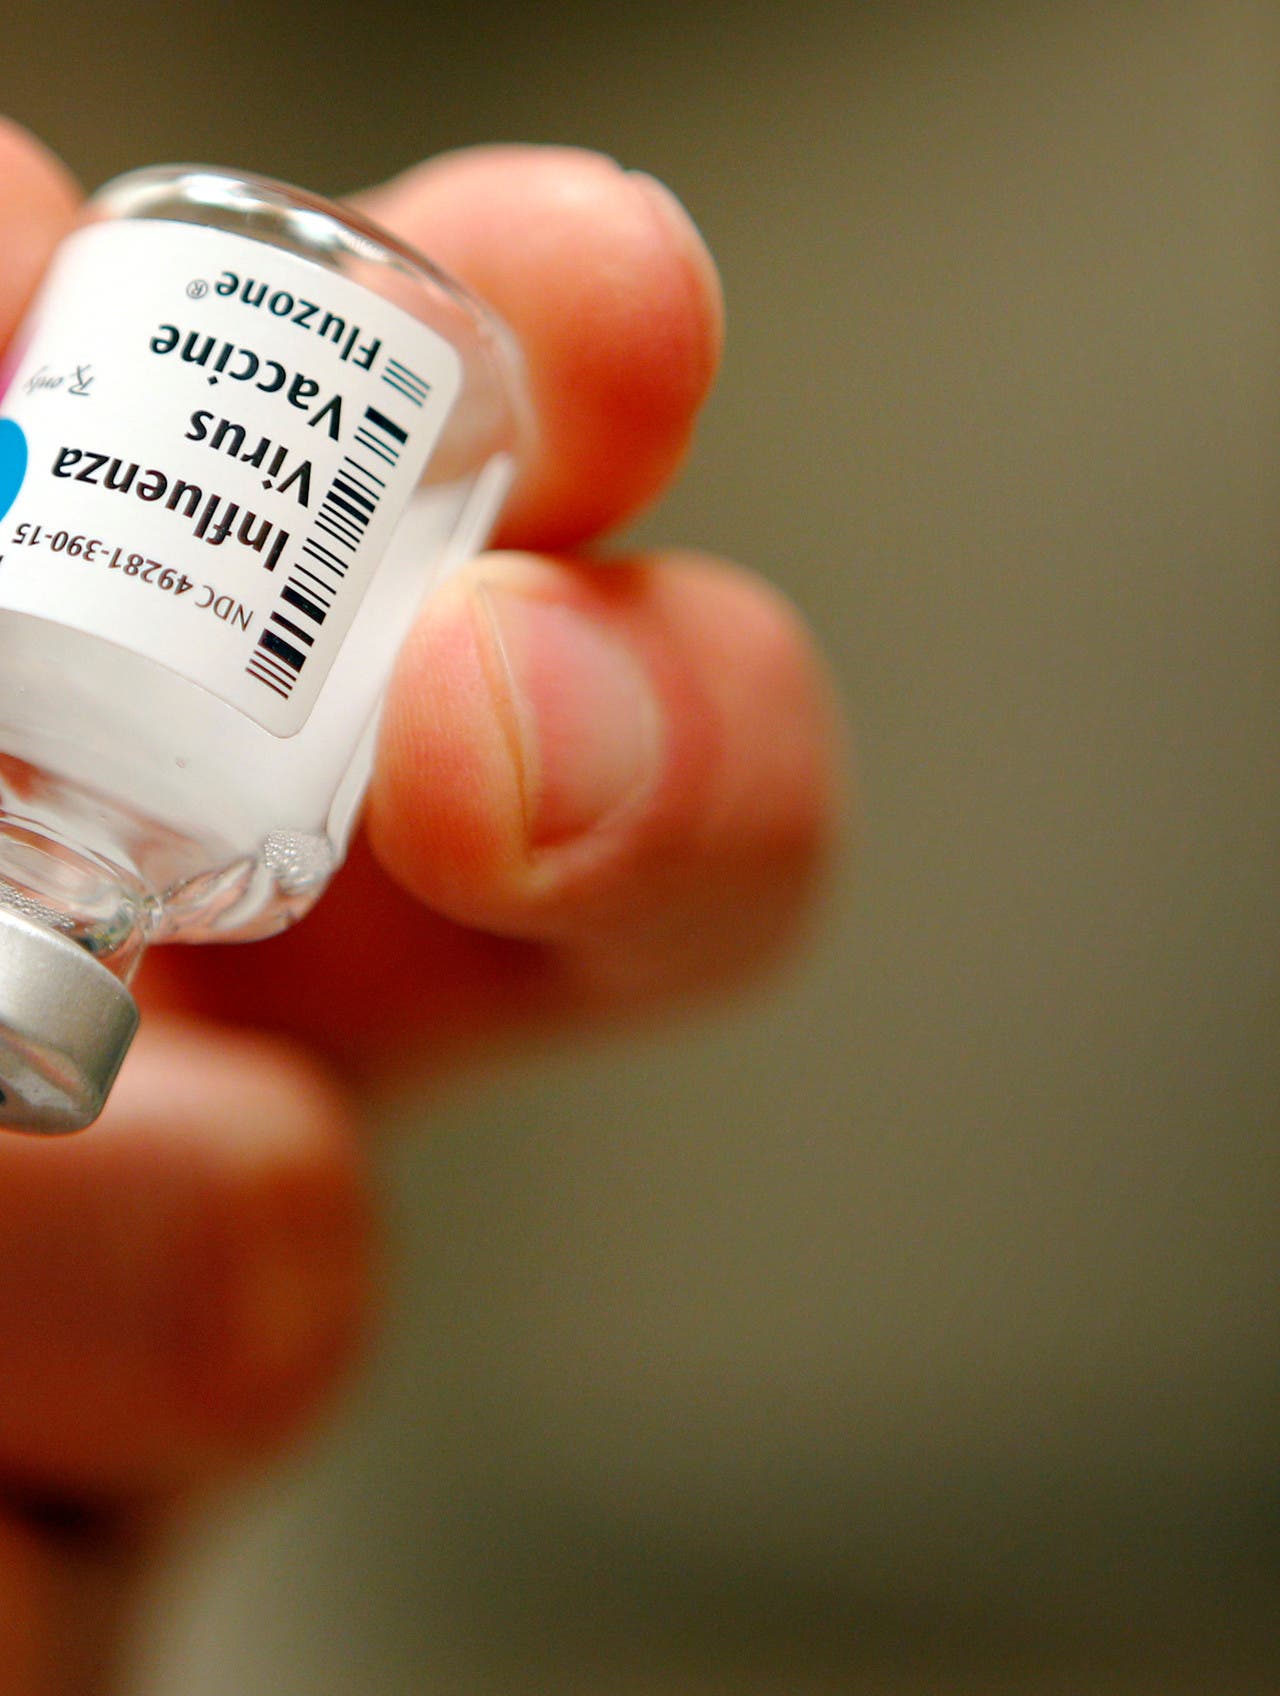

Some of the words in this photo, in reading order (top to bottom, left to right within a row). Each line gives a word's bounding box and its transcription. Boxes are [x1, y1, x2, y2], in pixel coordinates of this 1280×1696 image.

[149, 324, 343, 443] Vaccine
[184, 410, 313, 509] Virus
[11, 522, 194, 596] 49281-390-15
[51, 446, 290, 573] Influenza
[195, 585, 254, 632] NDC
